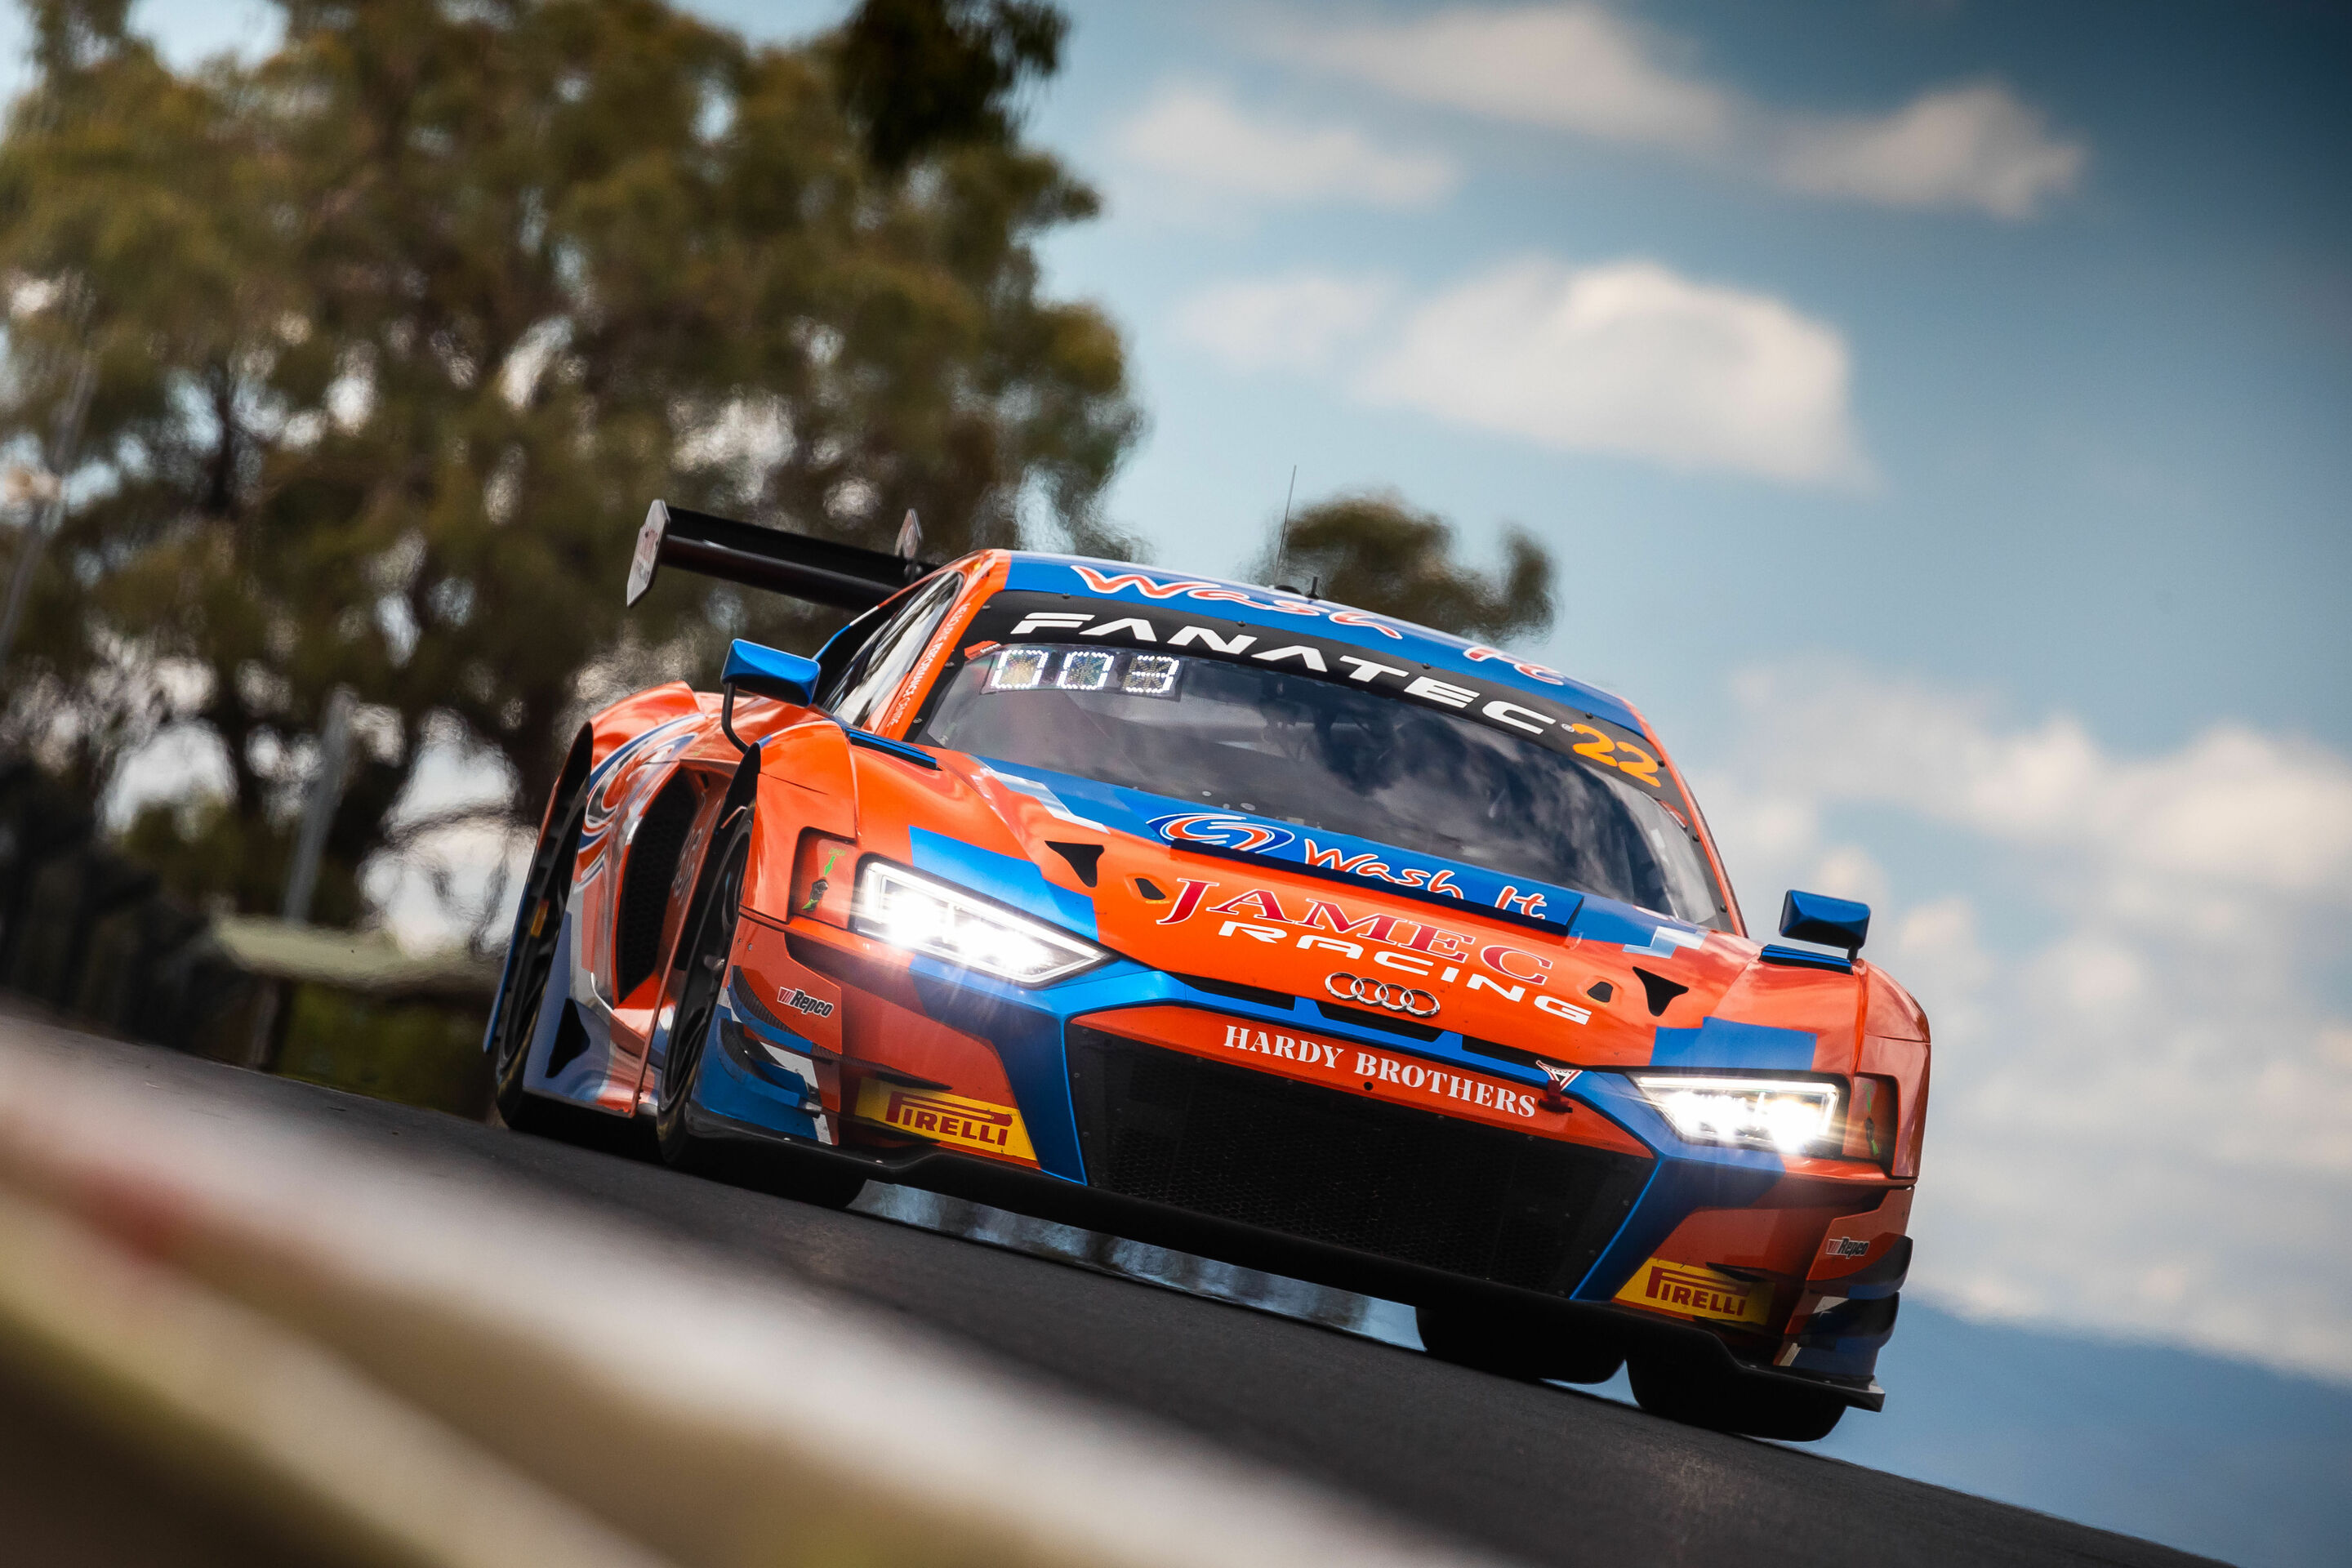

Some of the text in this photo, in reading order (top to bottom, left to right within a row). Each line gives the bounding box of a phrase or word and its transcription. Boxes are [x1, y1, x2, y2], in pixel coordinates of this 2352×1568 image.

[1010, 612, 1557, 735] FANATEC
[1571, 723, 1661, 788] 22
[1304, 838, 1548, 920] Wash It
[1156, 877, 1552, 986] JAMEC
[789, 988, 834, 1018] Repco
[1218, 920, 1592, 1026] RACING
[1223, 1024, 1536, 1118] HARDY BROTHERS
[884, 1090, 1013, 1147] PIRELLI
[1838, 1237, 1869, 1259] Repco
[1645, 1266, 1752, 1316] PIRELLI
